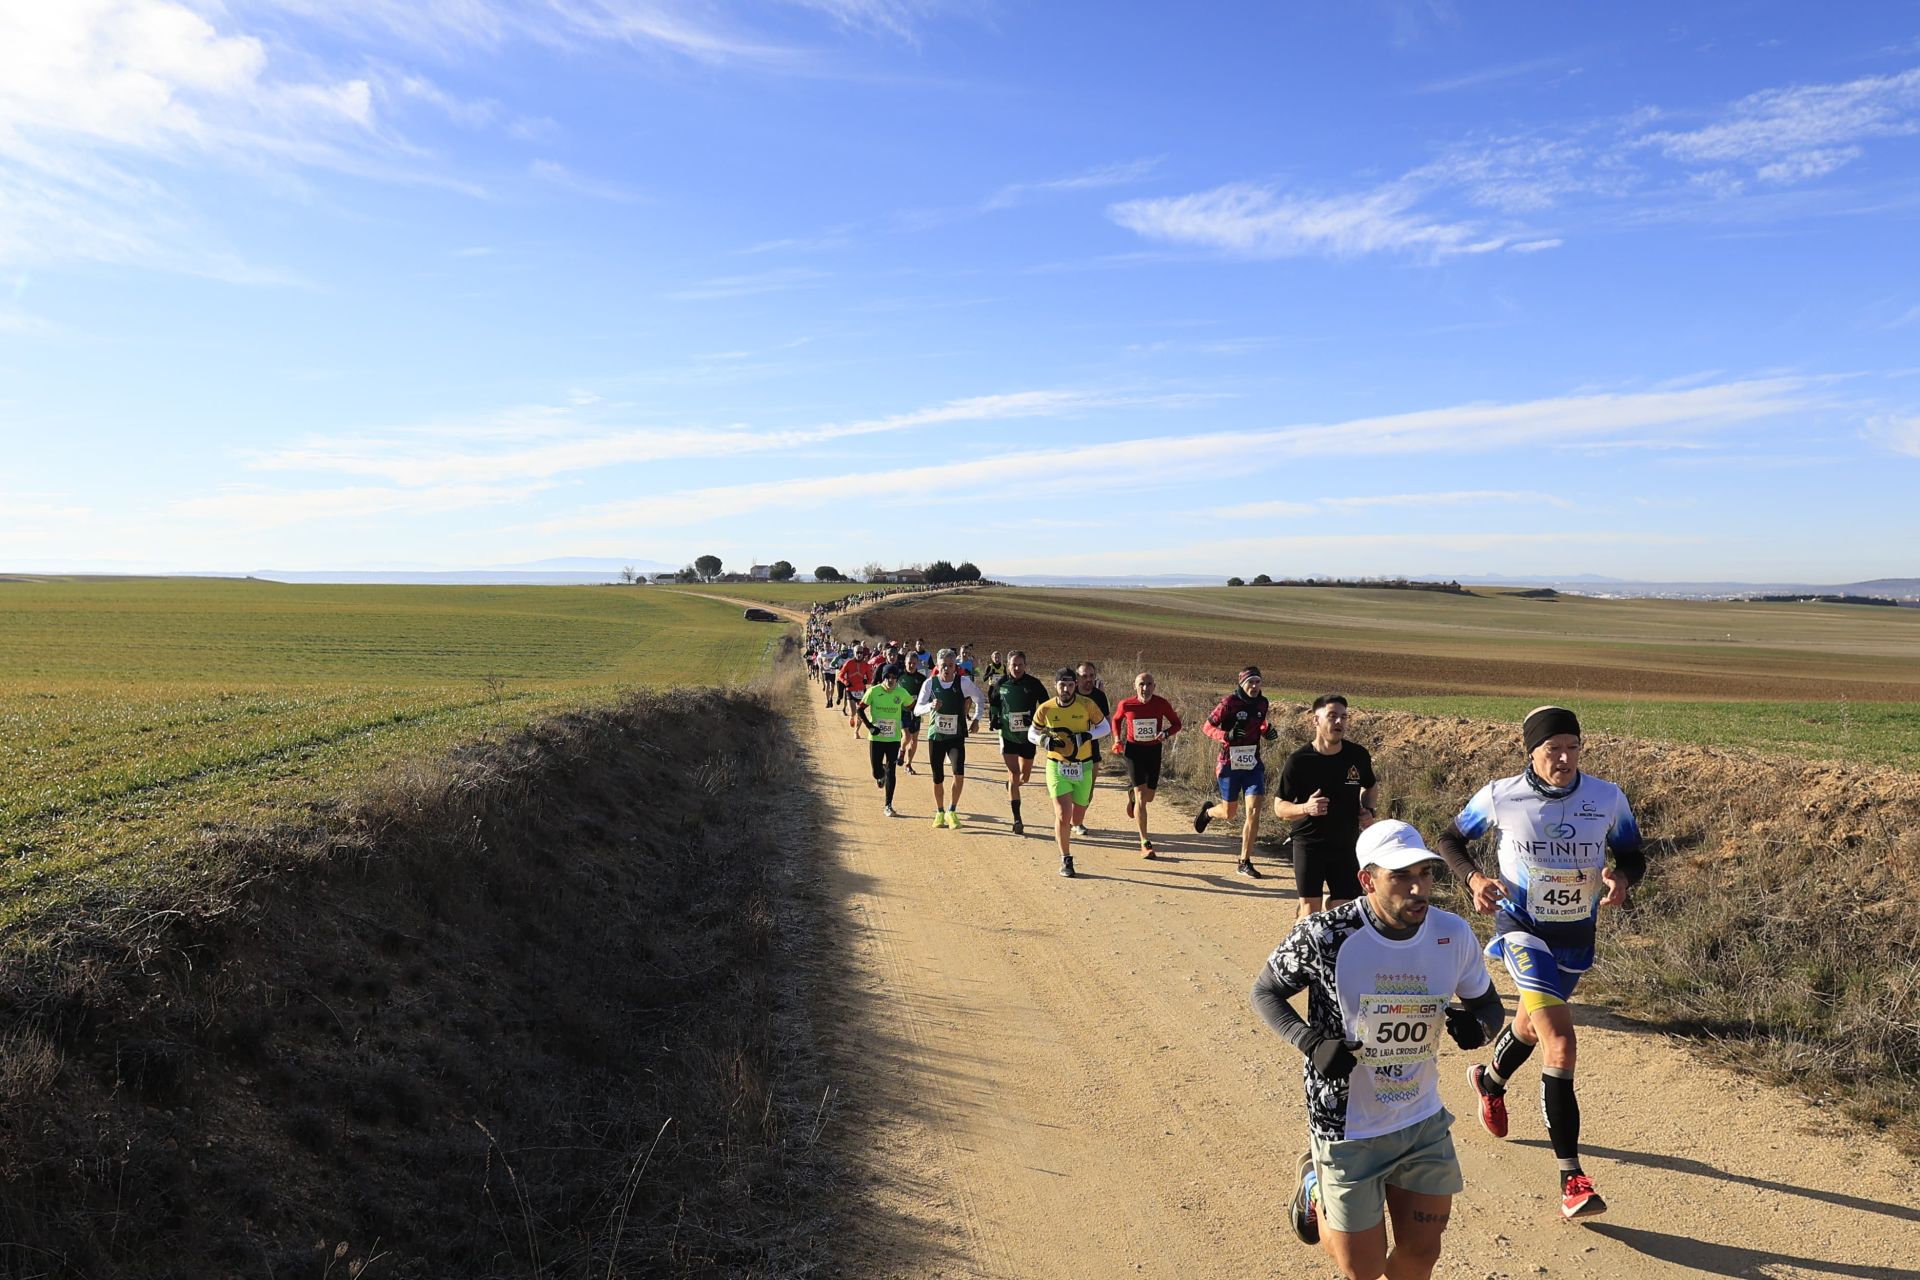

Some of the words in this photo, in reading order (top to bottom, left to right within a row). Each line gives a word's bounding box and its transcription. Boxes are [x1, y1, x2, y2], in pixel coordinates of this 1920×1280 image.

[1137, 727, 1153, 735] 283
[1237, 754, 1254, 763] 450
[1062, 768, 1079, 776] 1109
[1512, 840, 1603, 857] INFINITY
[1543, 888, 1582, 906] 454
[1535, 905, 1545, 915] 32
[1561, 908, 1577, 916] CROSS
[1515, 951, 1534, 973] PILA
[1373, 1004, 1437, 1015] JOMISAGA
[1376, 1021, 1428, 1044] 500
[1365, 1047, 1378, 1058] 32
[1380, 1048, 1394, 1057] LIGA
[1396, 1047, 1418, 1056] CROSS
